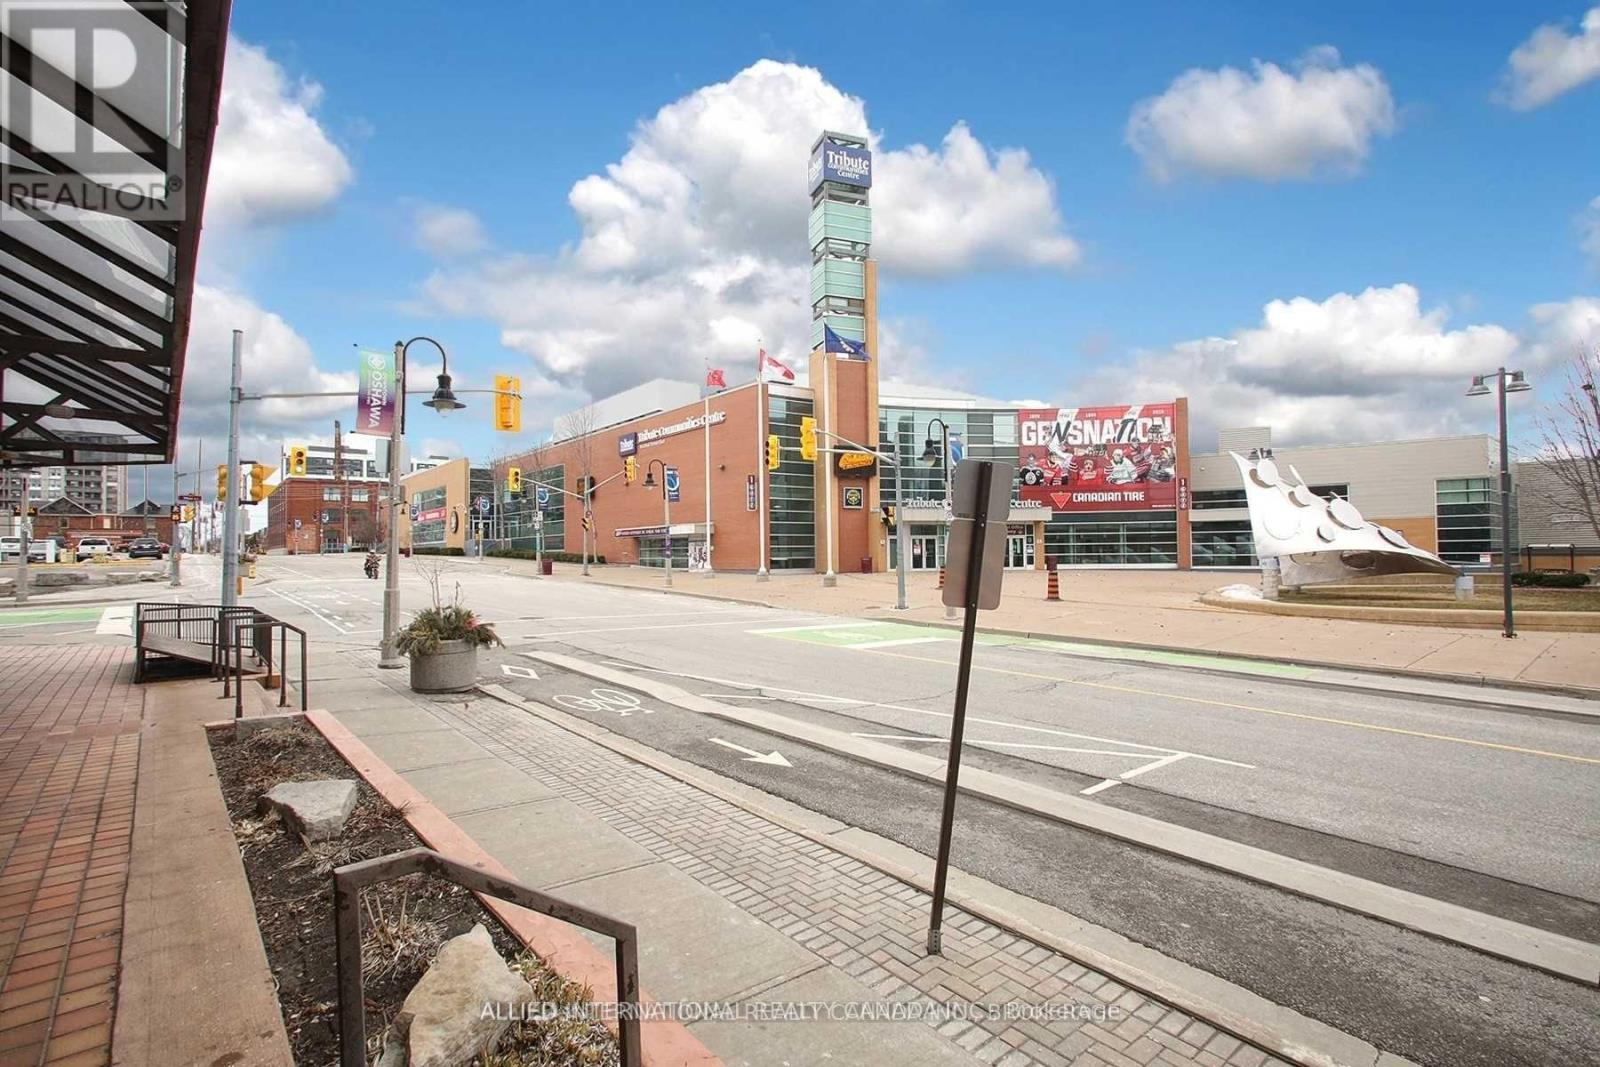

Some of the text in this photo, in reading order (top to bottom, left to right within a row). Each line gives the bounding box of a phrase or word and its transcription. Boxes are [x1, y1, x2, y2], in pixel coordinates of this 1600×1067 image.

[826, 150, 870, 171] Tribute
[837, 169, 860, 180] Centre
[367, 371, 382, 428] OSHAWA
[906, 496, 941, 508] Tribute
[1072, 491, 1145, 503] CANADIAN TIRE
